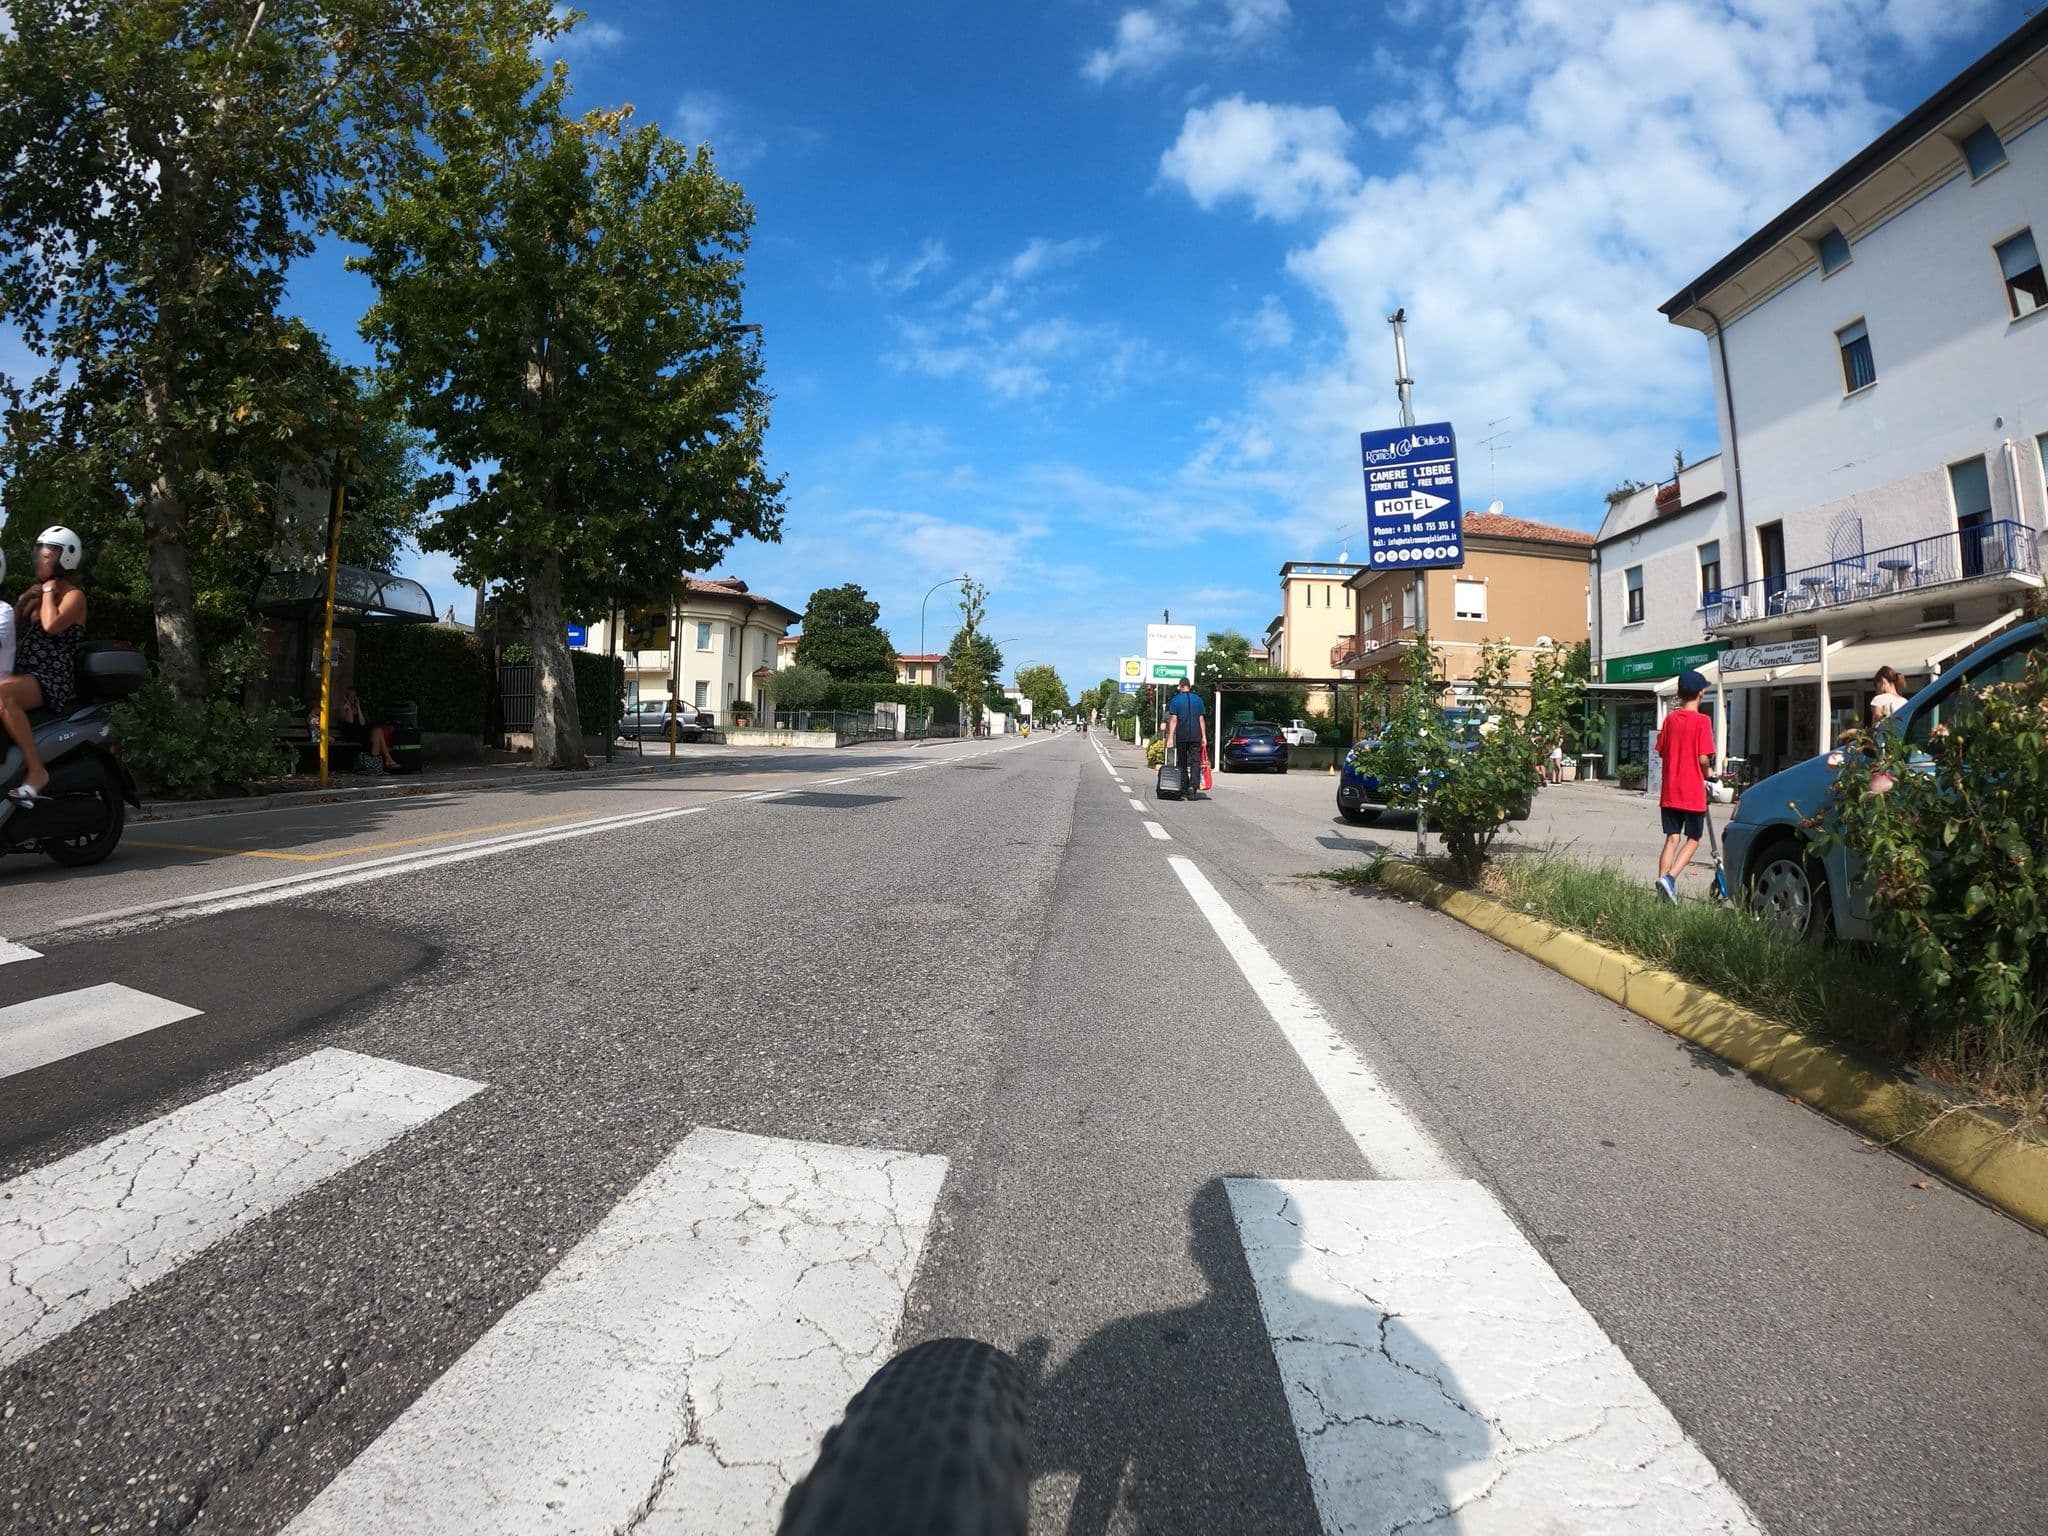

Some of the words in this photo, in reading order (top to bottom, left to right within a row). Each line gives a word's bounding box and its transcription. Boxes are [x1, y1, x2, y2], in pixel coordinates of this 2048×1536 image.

[1366, 451, 1396, 464] Romeo
[1370, 469, 1408, 482] CAMERE
[1413, 464, 1452, 477] LIBERE
[1418, 478, 1432, 486] FREE
[1435, 476, 1453, 485] ROOMS
[1382, 498, 1432, 512] HOTEL
[1721, 650, 1739, 670] La
[1746, 647, 1792, 667] Cremerie
